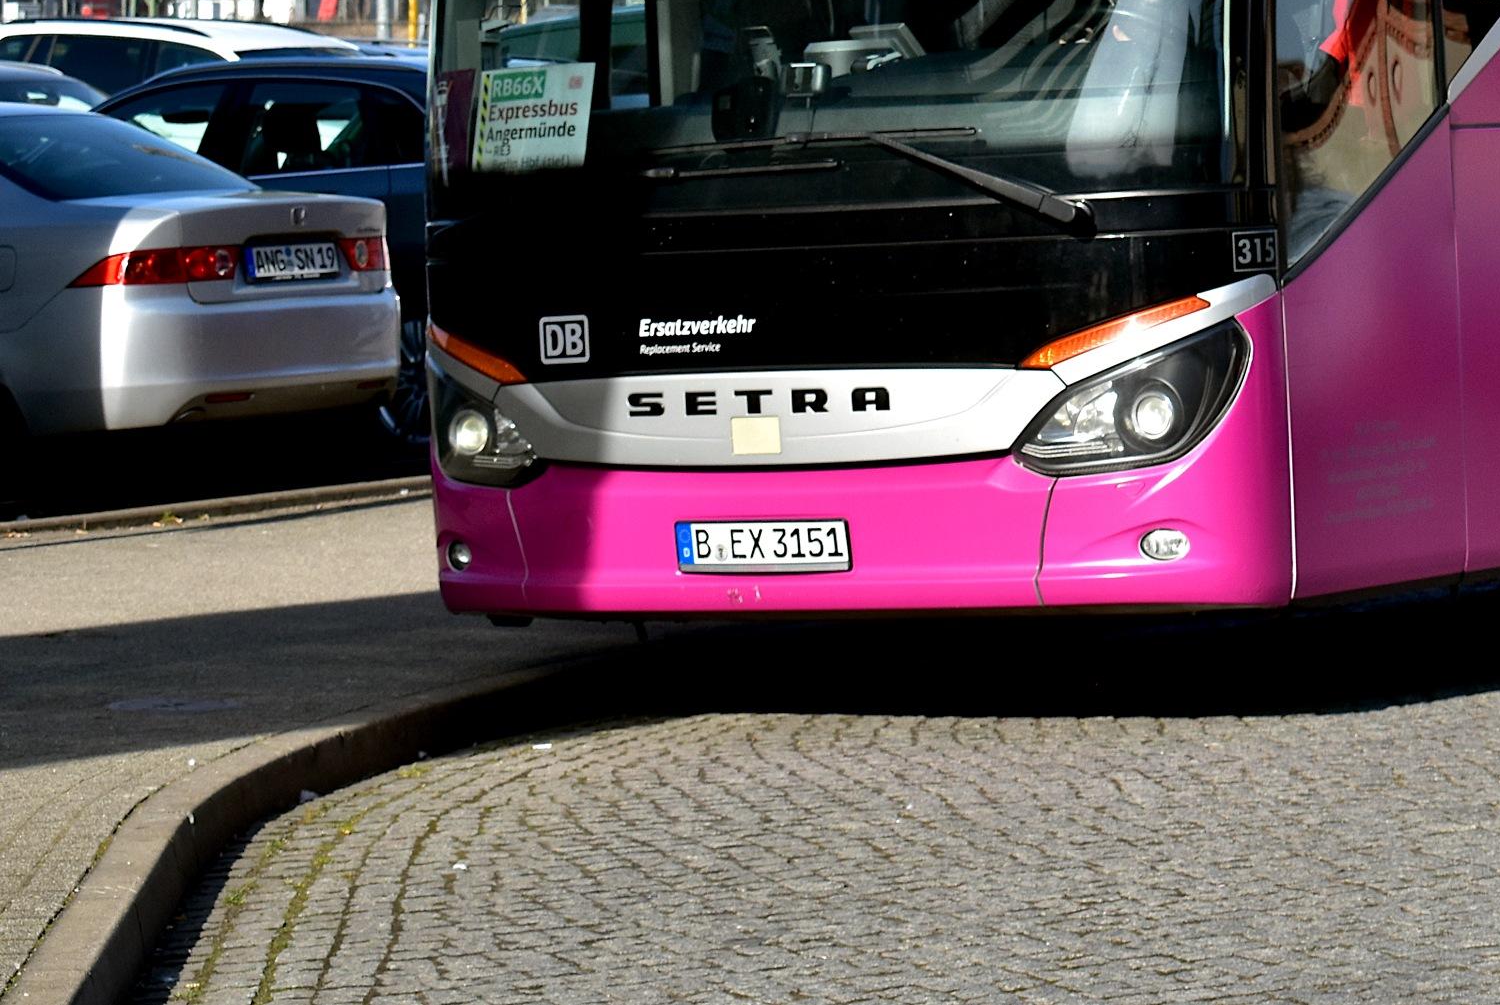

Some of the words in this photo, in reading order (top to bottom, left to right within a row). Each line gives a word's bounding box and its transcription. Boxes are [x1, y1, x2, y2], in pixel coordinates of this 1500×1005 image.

[492, 74, 546, 98] RB66X
[488, 99, 578, 124] Expressbus
[486, 120, 577, 146] Angermünde
[255, 248, 286, 274] ANG
[294, 247, 315, 271] SN
[319, 246, 336, 269] 19
[1237, 237, 1275, 264] 315
[638, 314, 757, 338] Ersatzverkehr
[544, 321, 587, 359] DB
[639, 342, 691, 356] Replacement
[691, 341, 722, 354] Service
[627, 386, 891, 417] SETRA
[695, 529, 711, 559] B
[730, 528, 765, 559] EX
[772, 527, 844, 558] 3151
